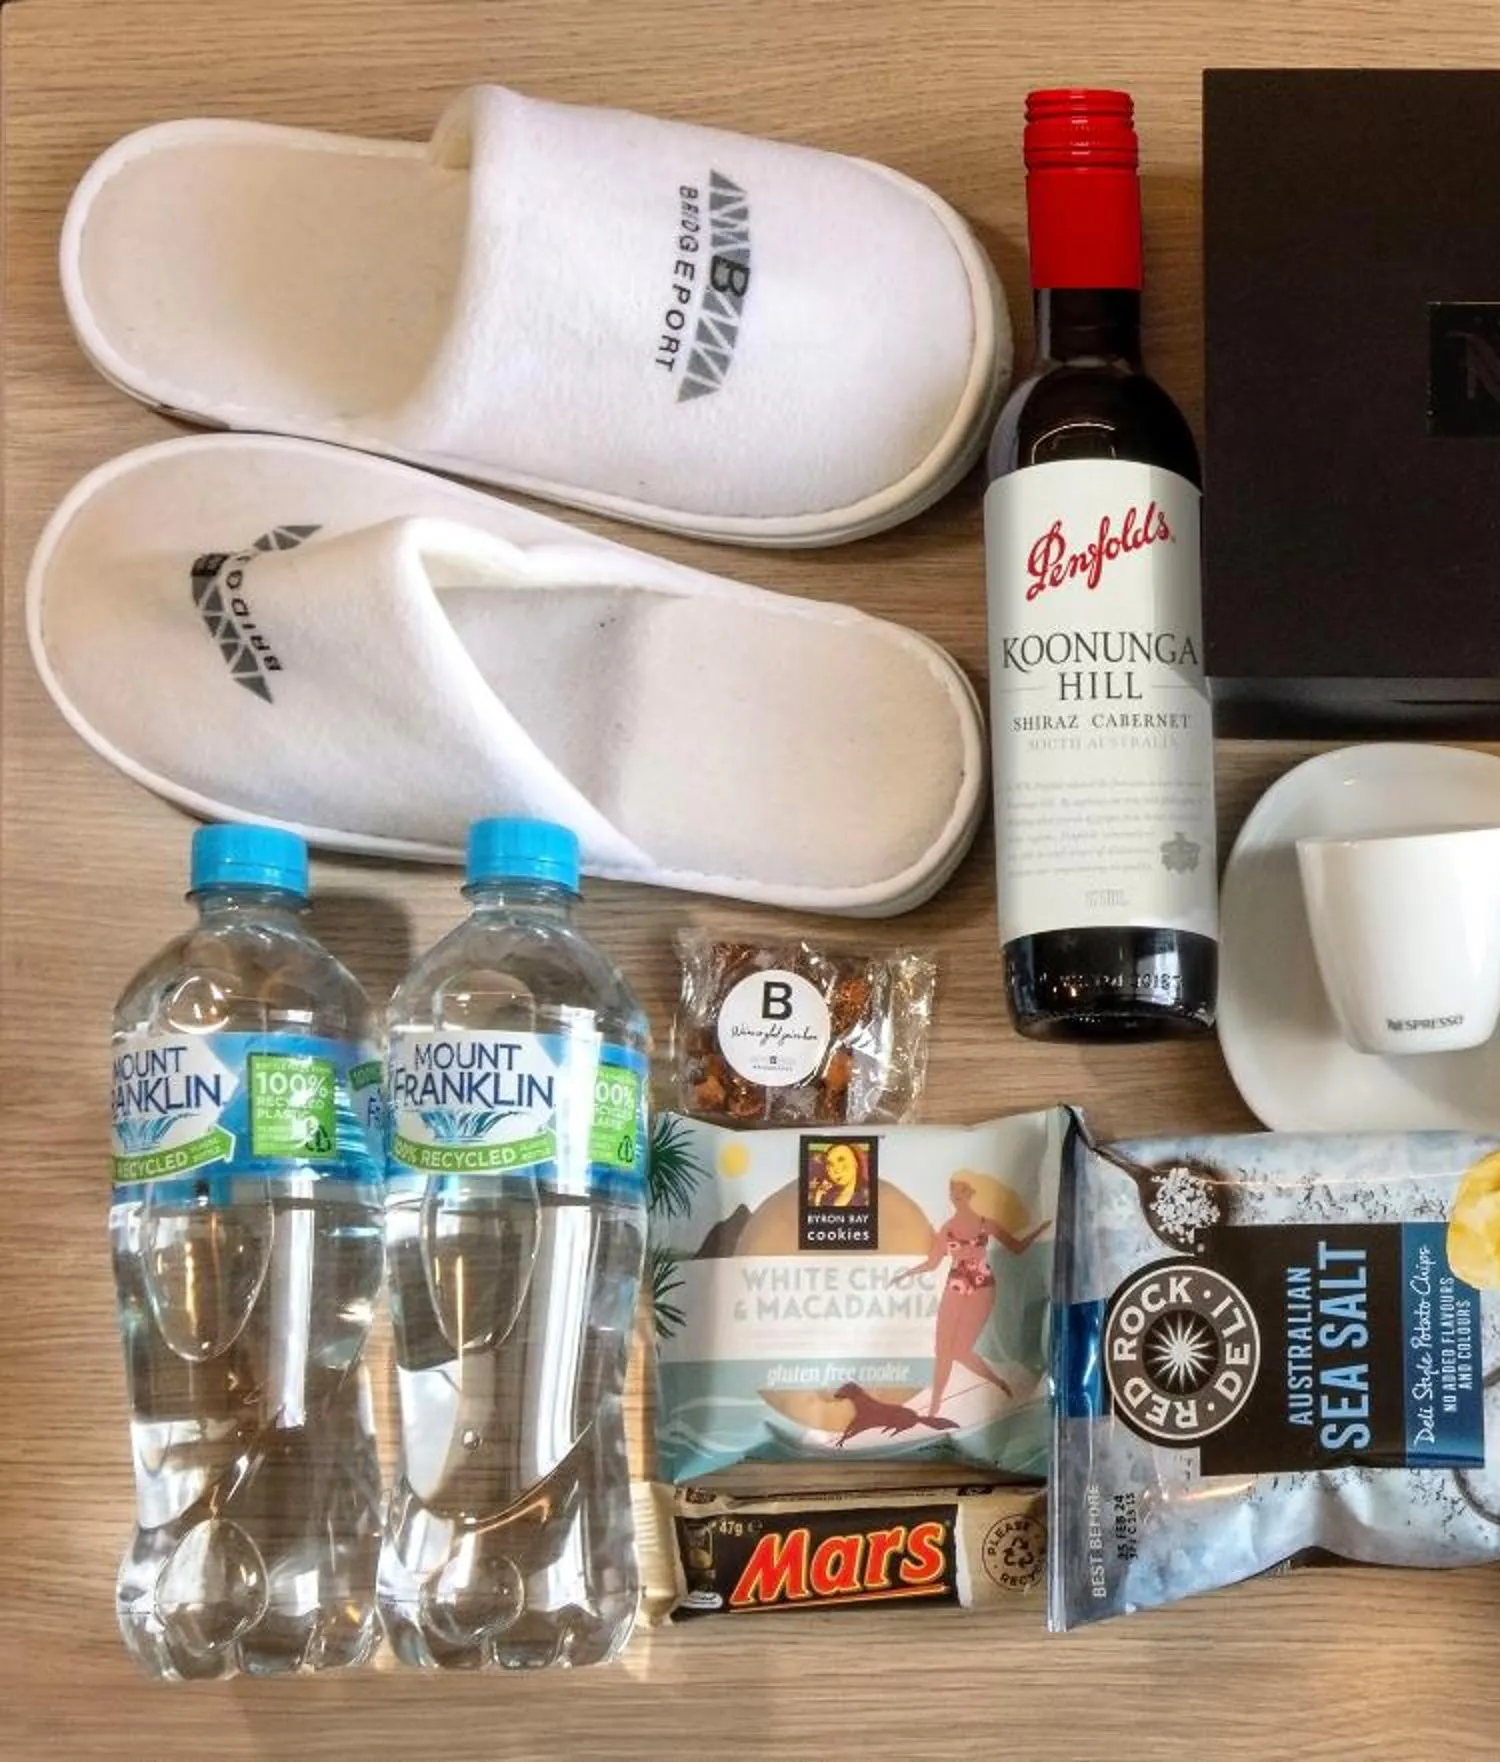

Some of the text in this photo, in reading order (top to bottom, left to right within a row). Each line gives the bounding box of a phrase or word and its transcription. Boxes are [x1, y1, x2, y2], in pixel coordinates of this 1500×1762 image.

[1026, 501, 1170, 601] Penfolds
[1002, 632, 1198, 673] KOONUNGA
[1058, 671, 1143, 701] HILL
[1013, 713, 1191, 731] SHIRAZ CABERNET
[761, 981, 793, 1020] B
[414, 1043, 522, 1072] MOUNT
[113, 1073, 222, 1116] ANKLIN
[256, 1071, 329, 1098] 100%
[393, 1067, 554, 1109] FRANKLIN
[421, 1147, 516, 1168] RECYCLED
[807, 1214, 869, 1225] BYRON BAY
[807, 1228, 870, 1241] cookies
[741, 1266, 936, 1292] WHITE CHOC
[1113, 1275, 1200, 1430] RED ROCK
[1211, 1295, 1250, 1402] DELI
[1286, 1266, 1314, 1427] AUSTRALIAN
[1317, 1240, 1371, 1450] SEA SALT
[1409, 1245, 1438, 1447] Deli Style Potato Chips
[1440, 1276, 1458, 1412] NO ADDED FLAVOURS
[1456, 1300, 1473, 1390] AND COLOURS
[767, 1362, 910, 1386] gluten free cookie
[1087, 1484, 1107, 1598] BEST BEFORE
[728, 1520, 946, 1607] Mars
